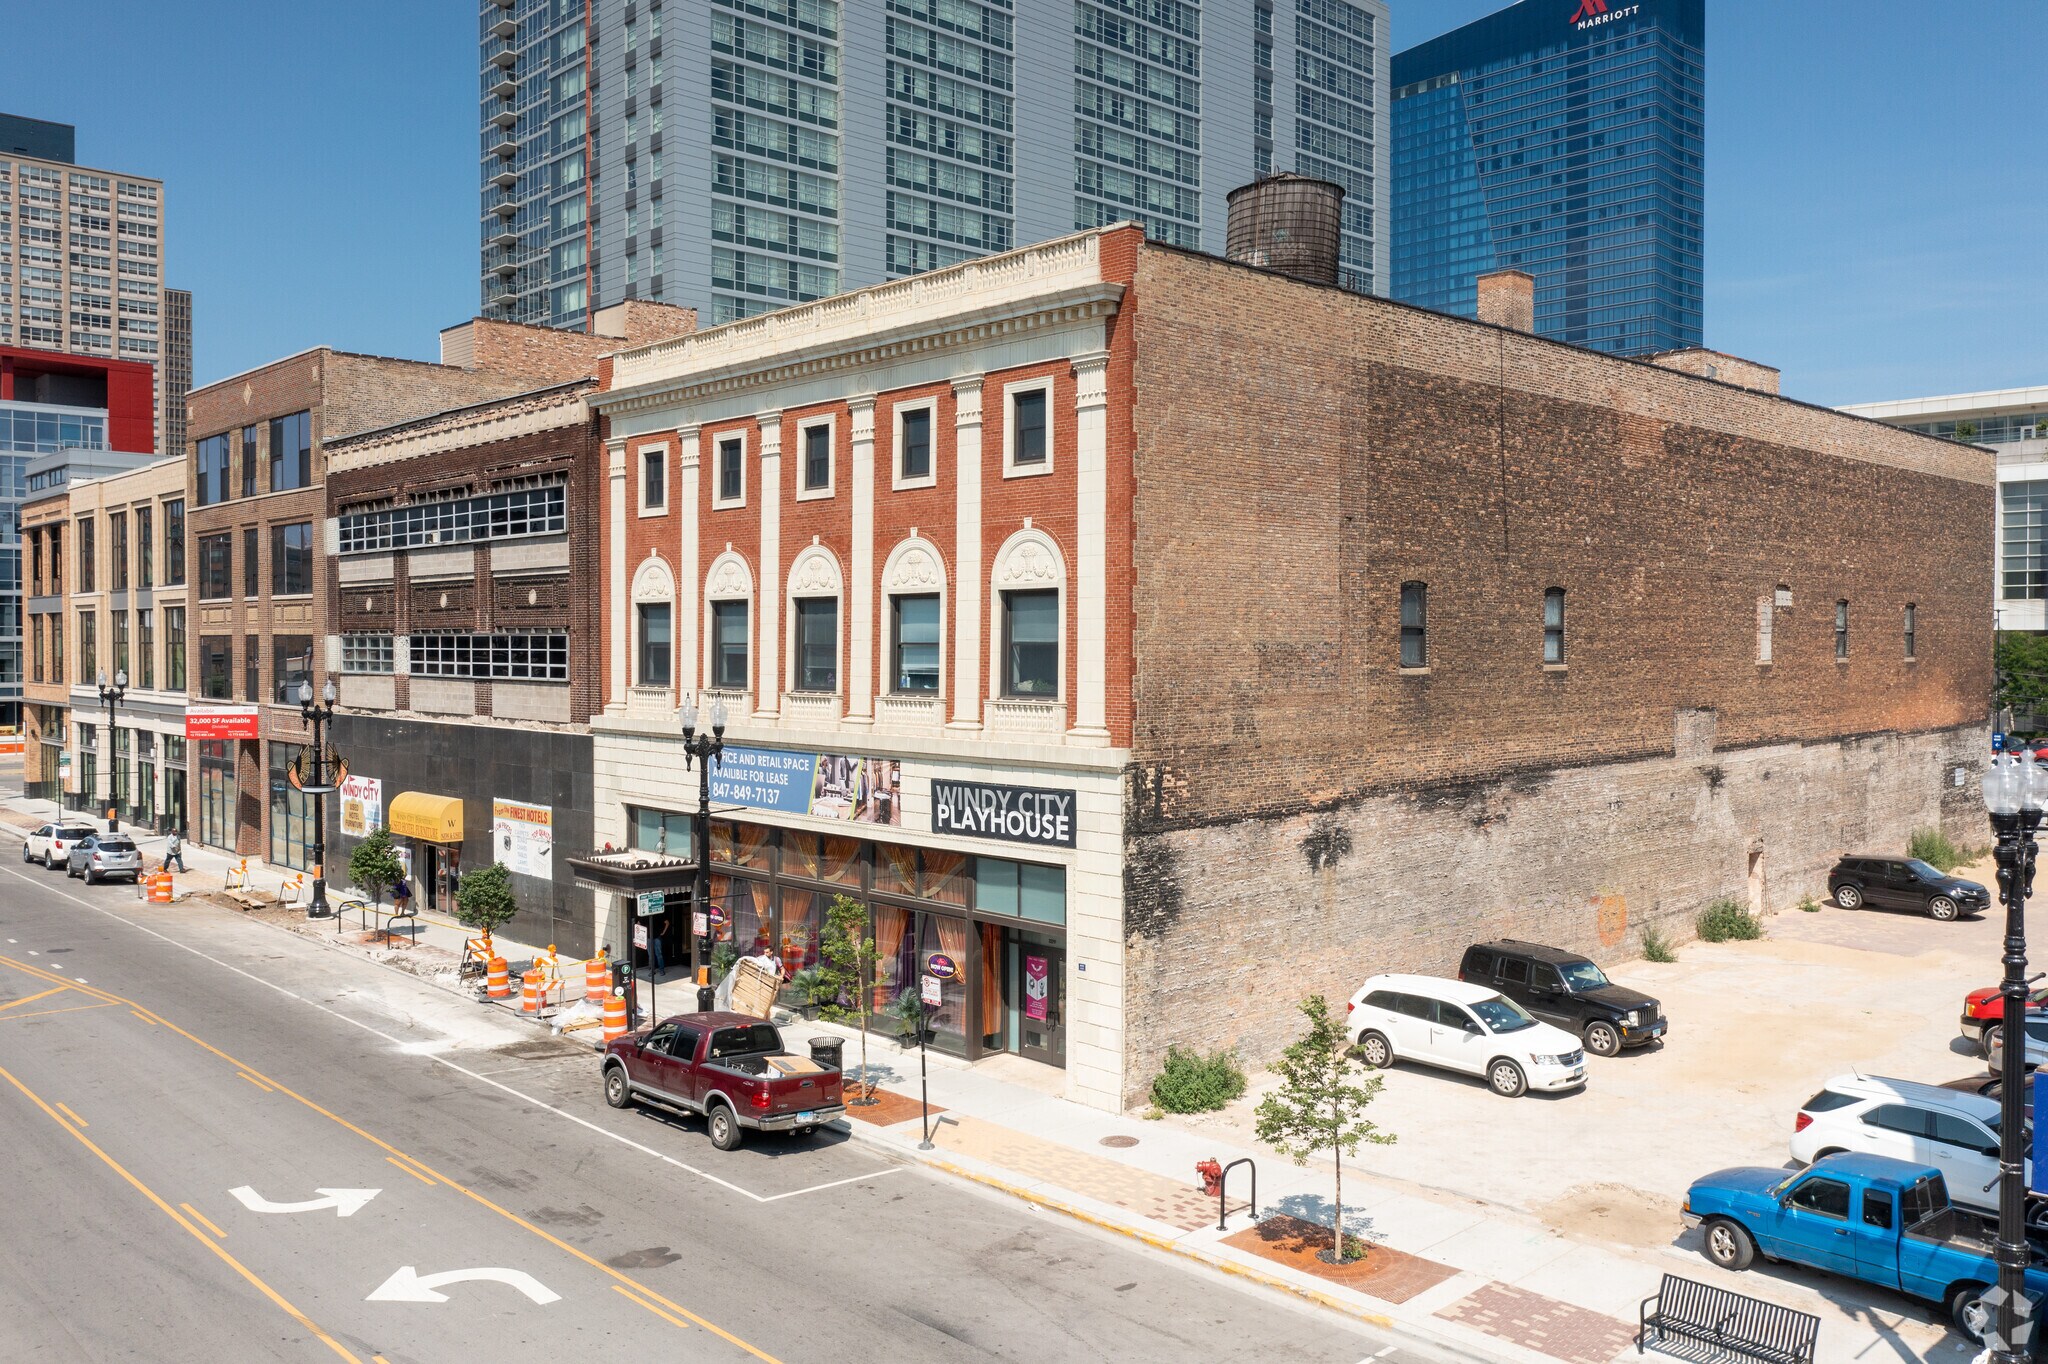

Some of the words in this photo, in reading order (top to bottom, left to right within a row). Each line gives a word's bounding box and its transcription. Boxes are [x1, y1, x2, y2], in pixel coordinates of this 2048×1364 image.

[1577, 5, 1639, 30] MARRIOTT
[190, 717, 211, 725] 32,000
[739, 753, 756, 766] AND
[757, 755, 782, 769] RETAIL
[783, 758, 809, 771] SPACE
[750, 770, 765, 782] FOR
[766, 772, 788, 786] LEASE
[363, 782, 379, 801] CITY
[712, 782, 780, 804] 847-849-7137
[935, 785, 1012, 815] WINDY
[1018, 792, 1071, 816] CITY
[447, 819, 457, 828] W
[510, 807, 525, 820] FINEST
[527, 809, 547, 824] HOTELS
[937, 803, 1070, 841] PLAYHOUSE
